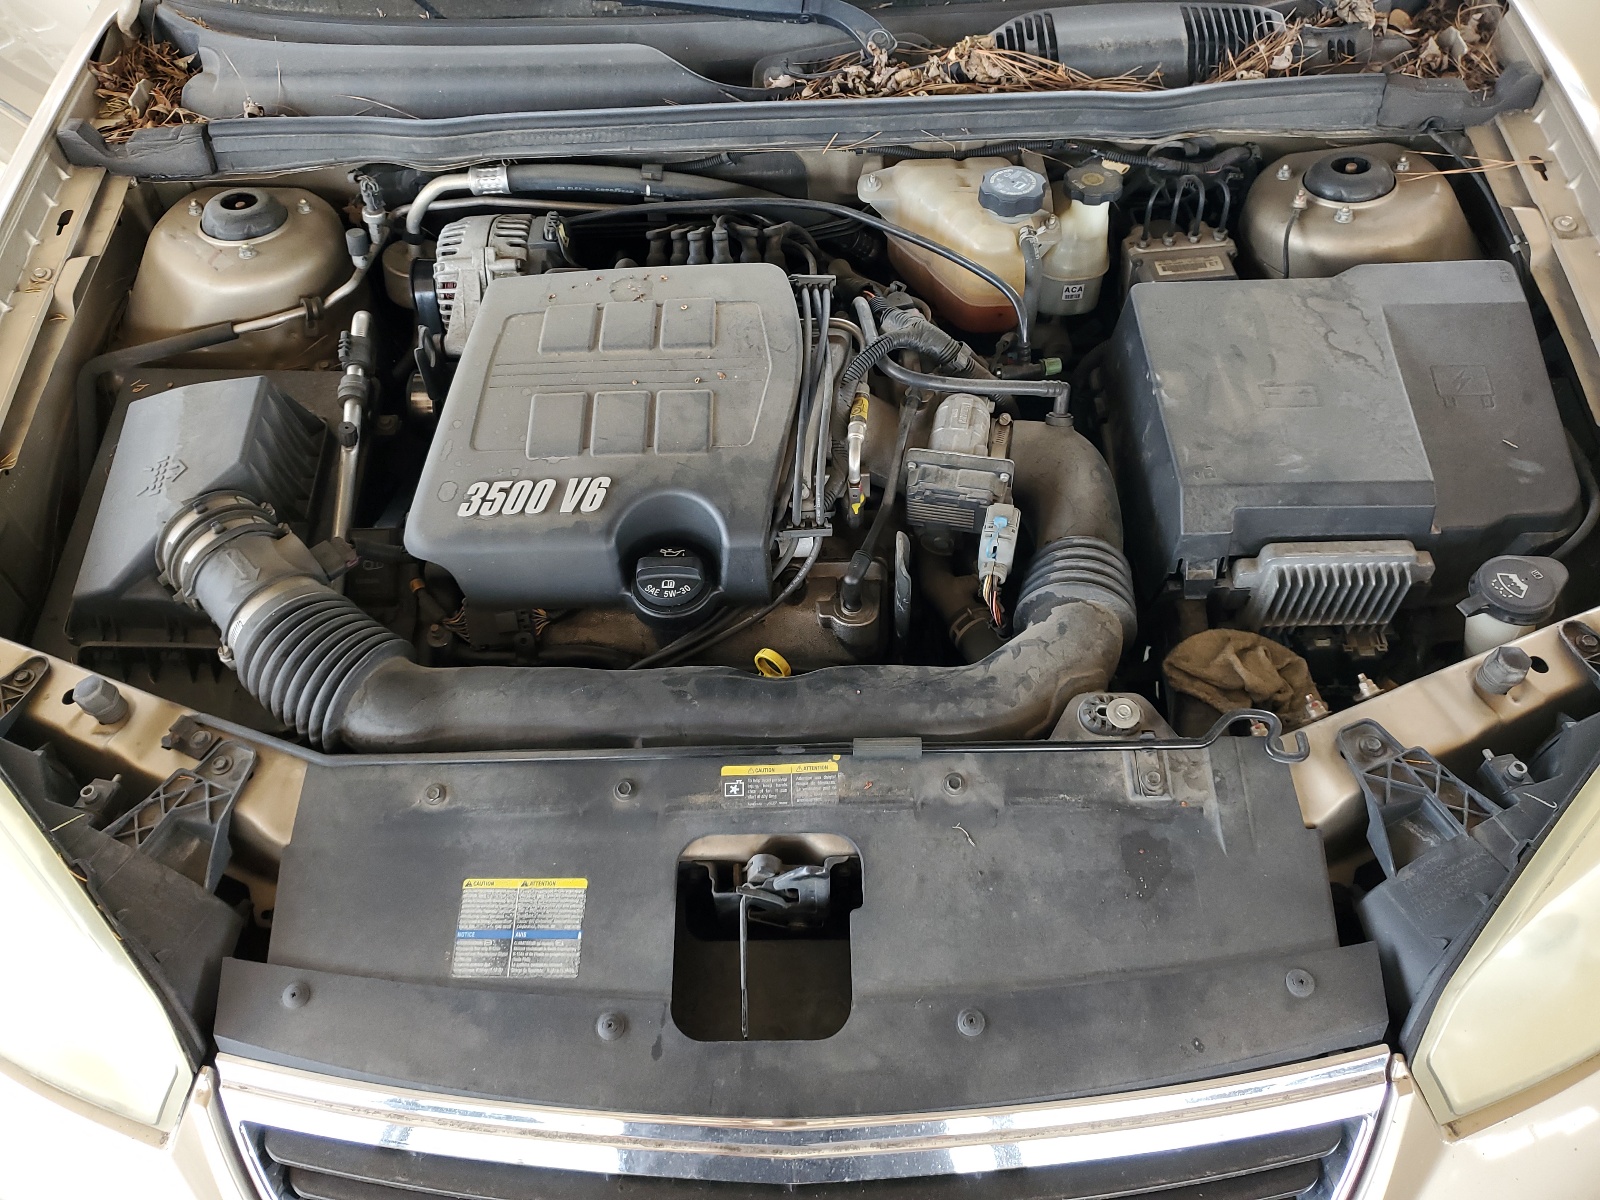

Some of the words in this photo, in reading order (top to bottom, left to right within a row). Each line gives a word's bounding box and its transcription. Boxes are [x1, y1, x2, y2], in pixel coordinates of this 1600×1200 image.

[457, 478, 557, 518] 3500
[560, 476, 612, 514] V6
[644, 584, 660, 597] SAE
[663, 585, 691, 598] 5W-30
